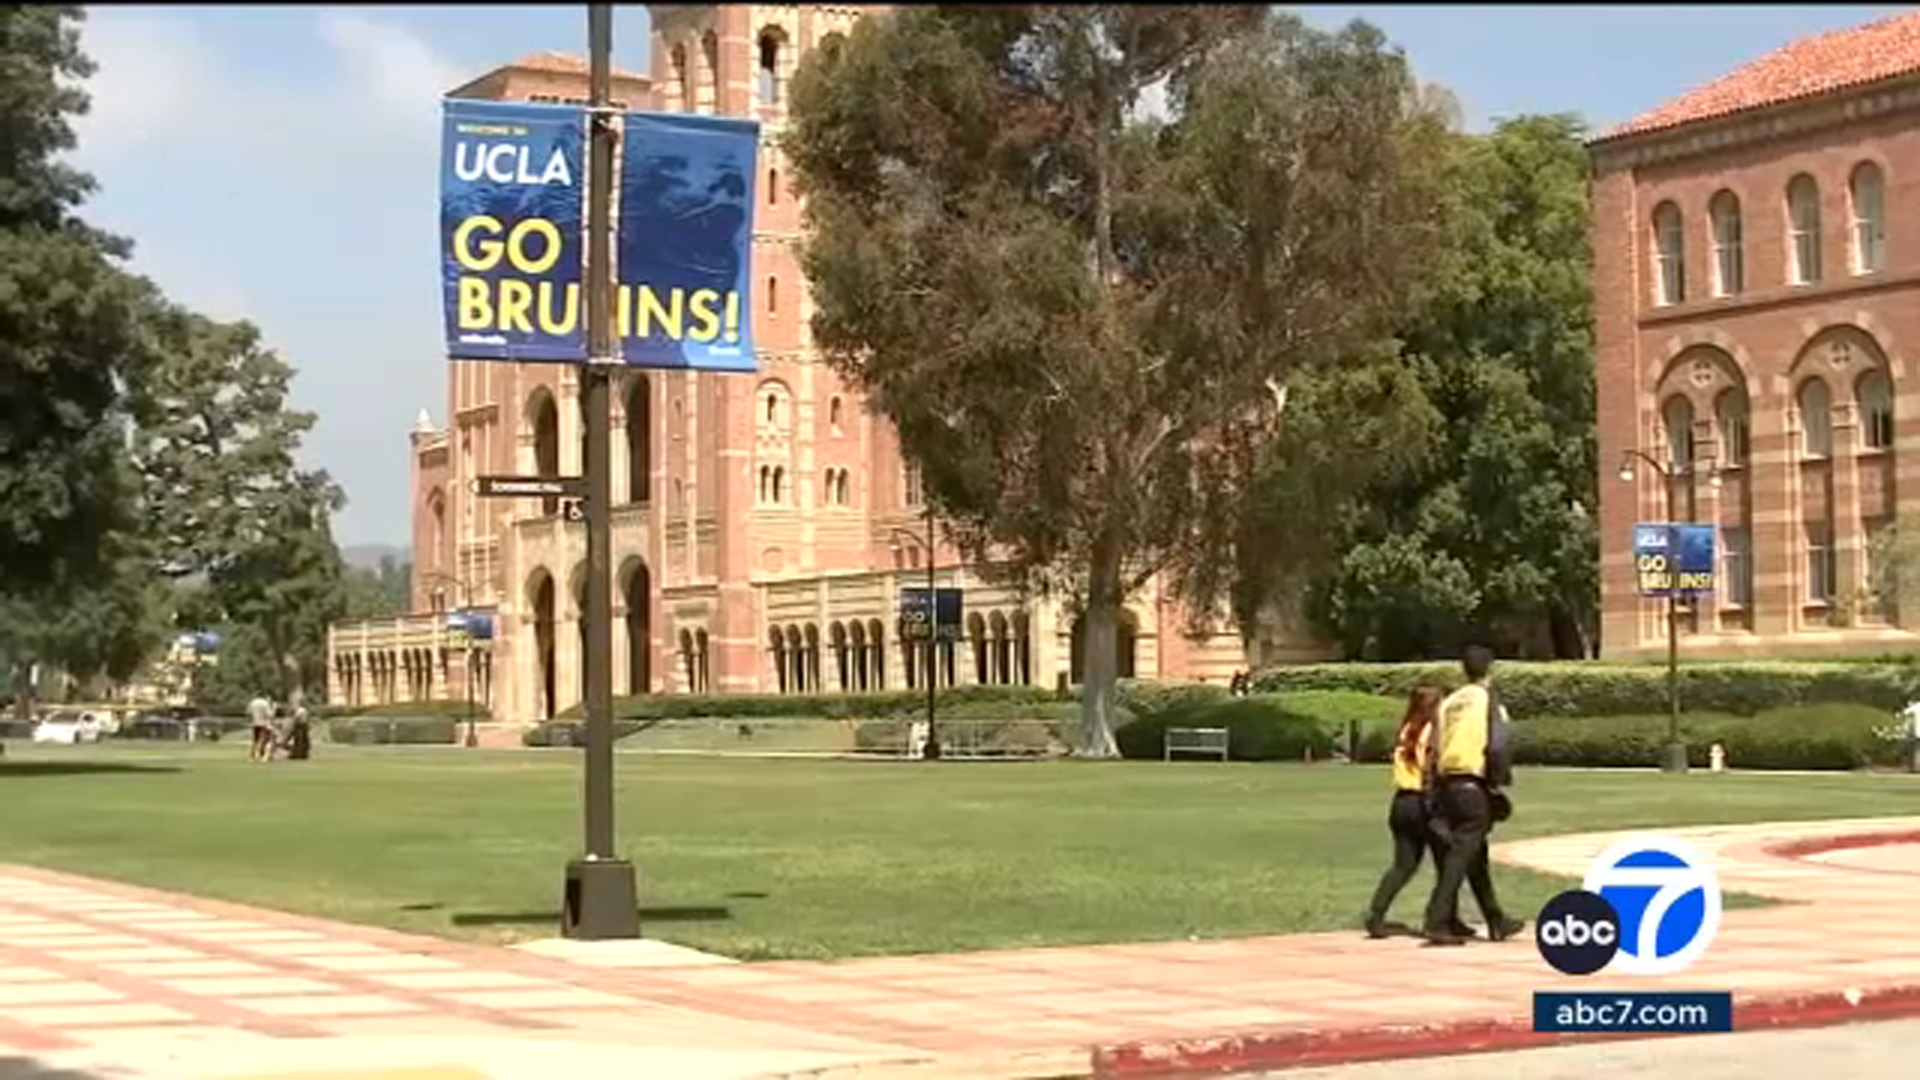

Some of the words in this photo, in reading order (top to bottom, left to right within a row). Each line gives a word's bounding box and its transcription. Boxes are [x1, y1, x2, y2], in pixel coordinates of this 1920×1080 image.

[455, 143, 572, 187] UCLA
[454, 215, 562, 274] GO
[1638, 554, 1667, 572] GO
